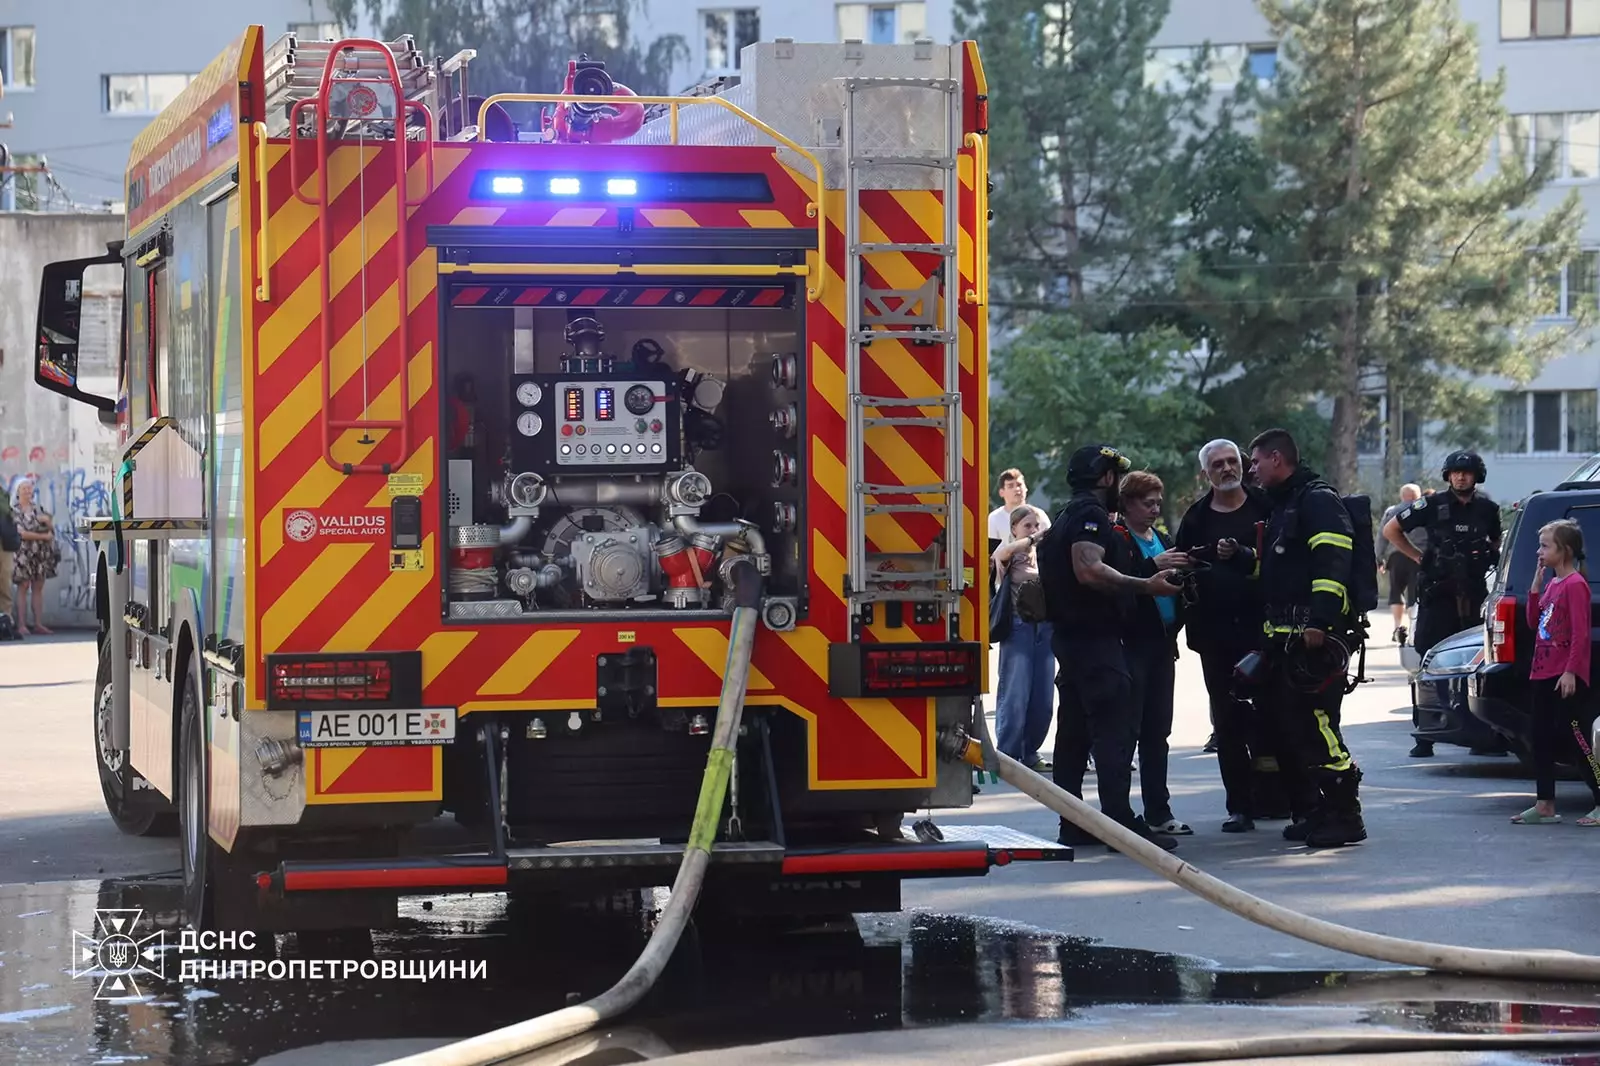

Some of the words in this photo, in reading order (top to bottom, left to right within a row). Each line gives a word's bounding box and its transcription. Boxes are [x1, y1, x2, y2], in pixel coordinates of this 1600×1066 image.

[319, 516, 385, 527] VALIDUS
[360, 527, 385, 535] AUTO
[316, 714, 350, 738] AE
[358, 713, 398, 737] 001
[406, 712, 422, 735] E
[299, 730, 311, 738] UA
